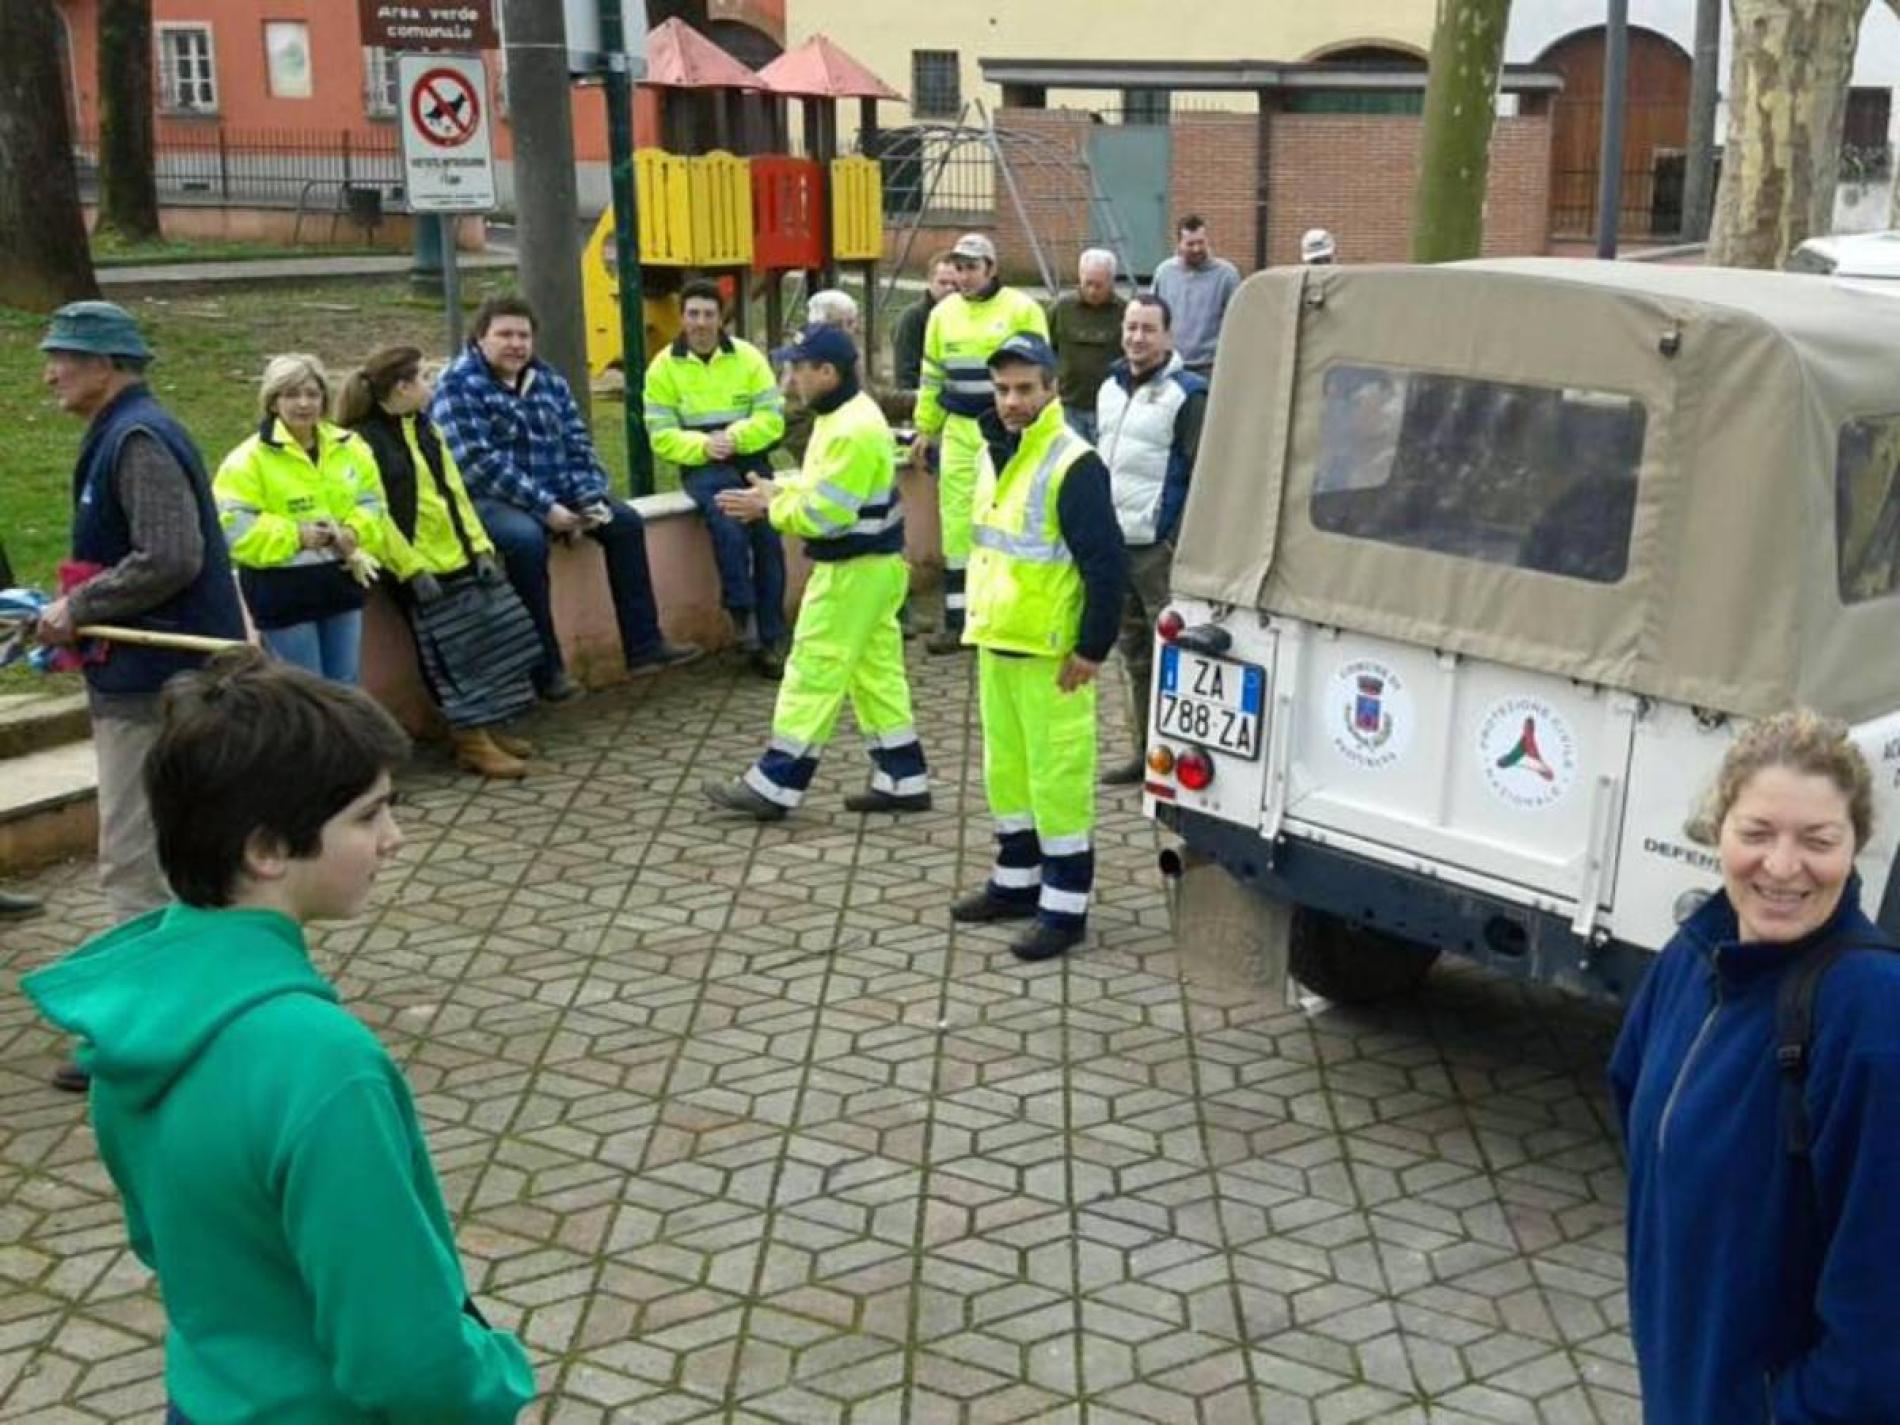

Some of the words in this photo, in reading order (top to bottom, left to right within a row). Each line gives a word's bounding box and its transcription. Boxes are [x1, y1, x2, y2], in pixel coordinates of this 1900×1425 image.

[377, 7, 419, 19] Area
[431, 6, 479, 20] verde
[386, 24, 473, 38] comunale
[1194, 660, 1223, 700] ZA
[1162, 694, 1210, 738] 788
[1219, 710, 1250, 752] ZA
